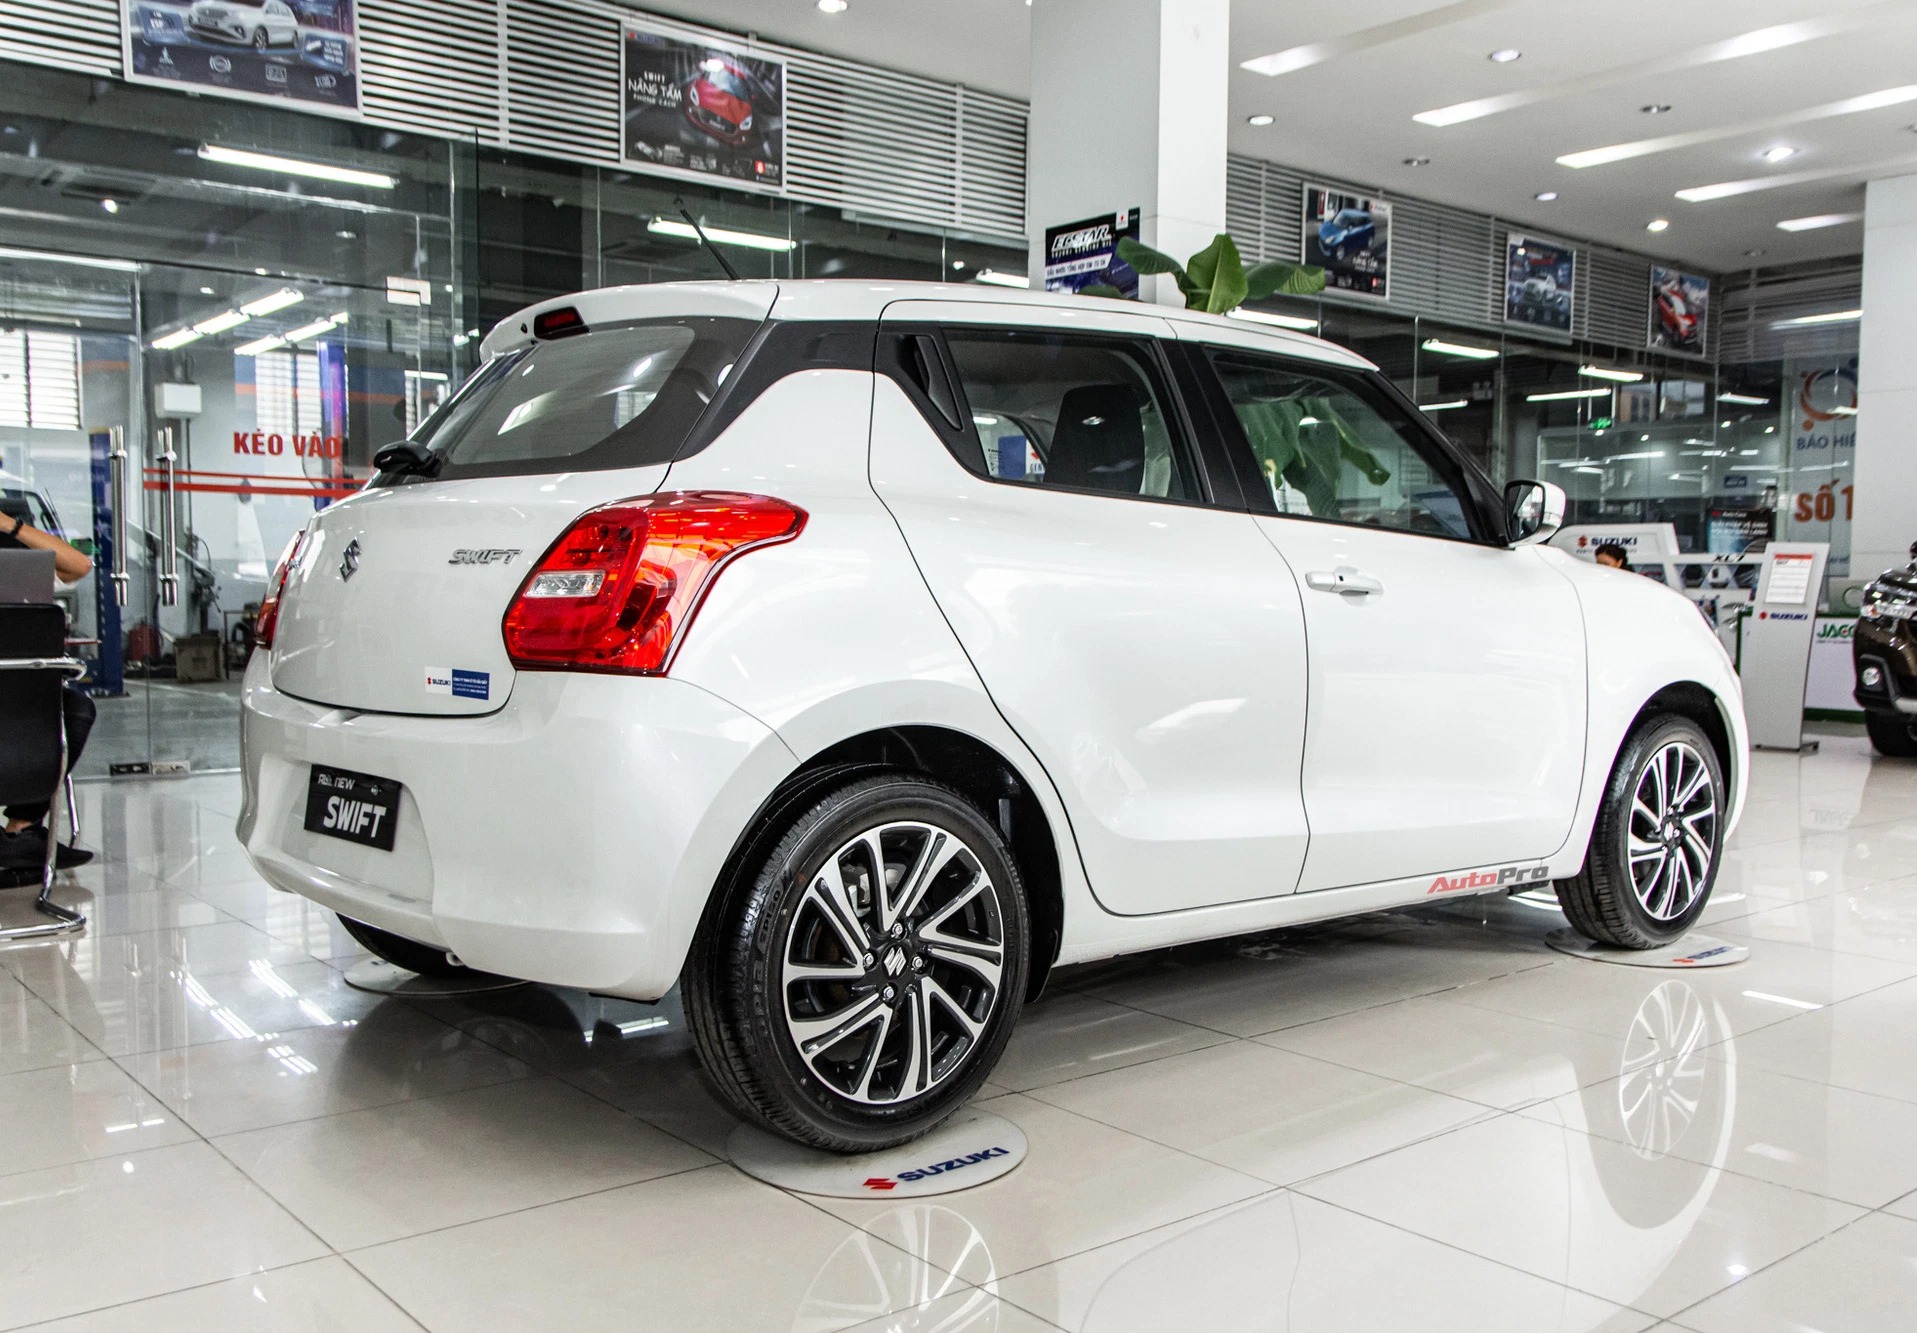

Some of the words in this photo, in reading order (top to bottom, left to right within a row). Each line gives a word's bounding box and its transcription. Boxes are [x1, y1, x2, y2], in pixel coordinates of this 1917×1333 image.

[1794, 478, 1841, 523] SỐ
[1840, 485, 1854, 522] 1
[1590, 536, 1638, 547] SUZUKI
[447, 548, 523, 565] SWIFT
[1769, 612, 1809, 621] SUZUKI
[432, 678, 452, 686] SUZUKI
[323, 795, 387, 838] SWIFT
[896, 1146, 1011, 1182] SUZUKI
